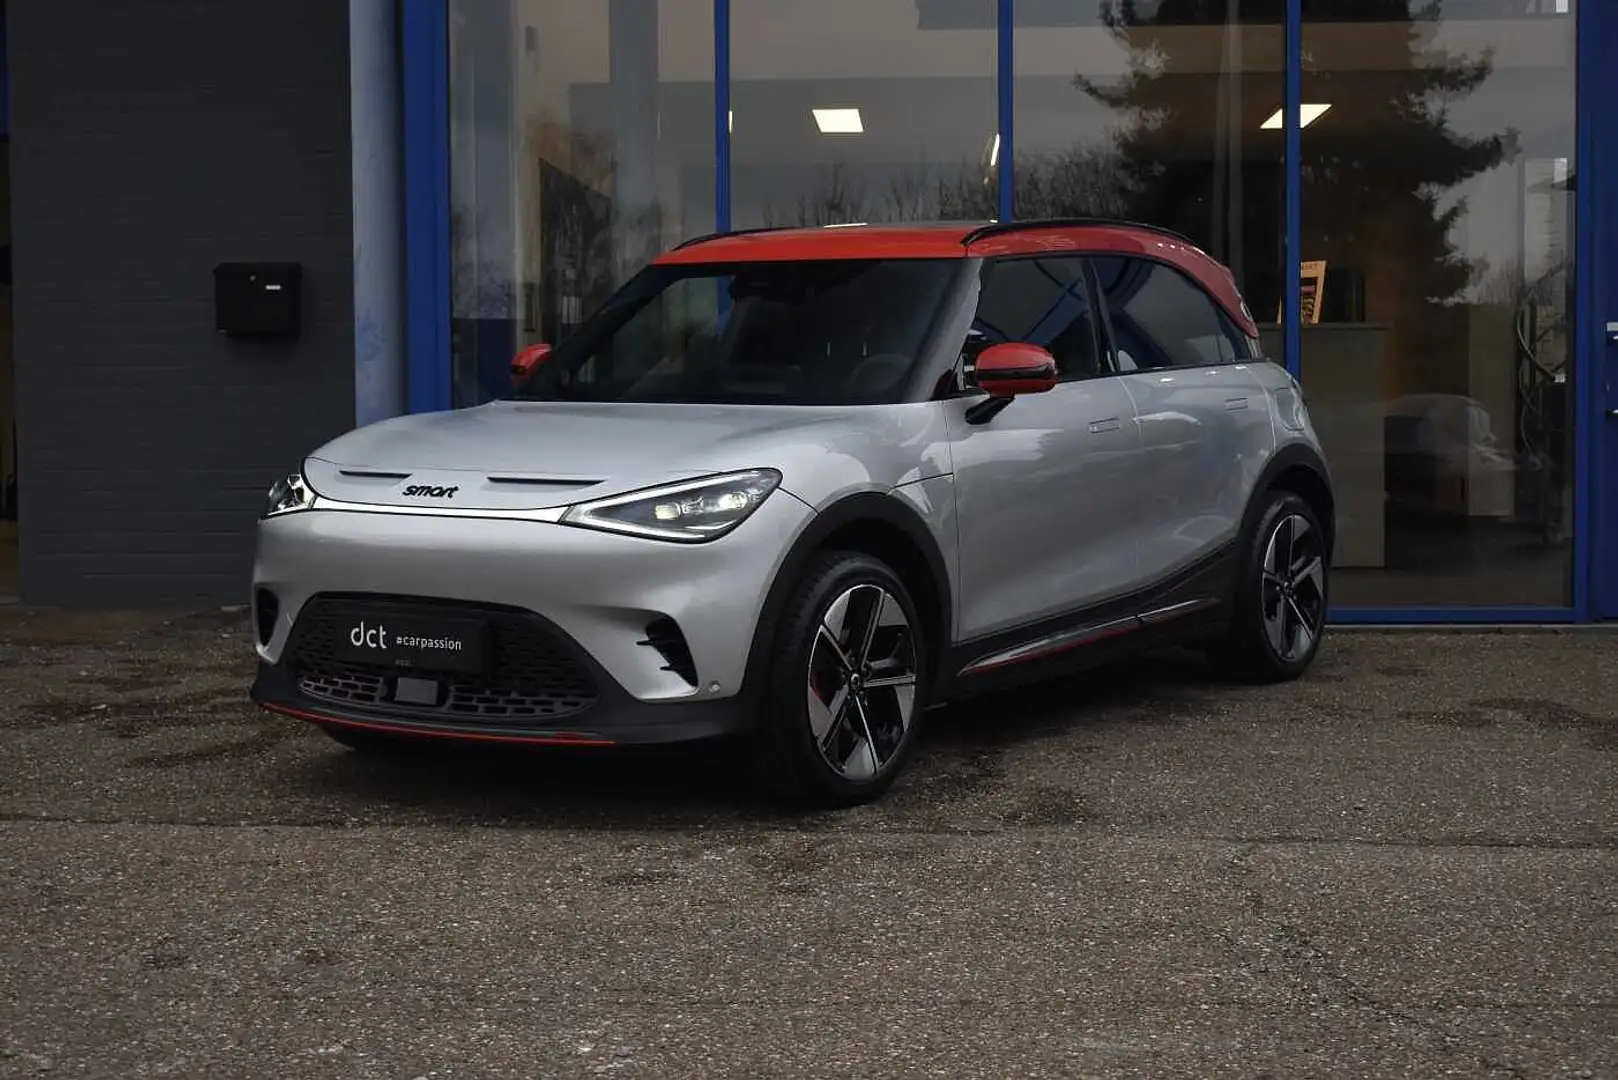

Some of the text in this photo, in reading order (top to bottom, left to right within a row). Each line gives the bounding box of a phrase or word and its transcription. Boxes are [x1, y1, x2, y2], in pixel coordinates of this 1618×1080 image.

[402, 485, 459, 499] smart
[350, 620, 463, 651] dct #carpassion
